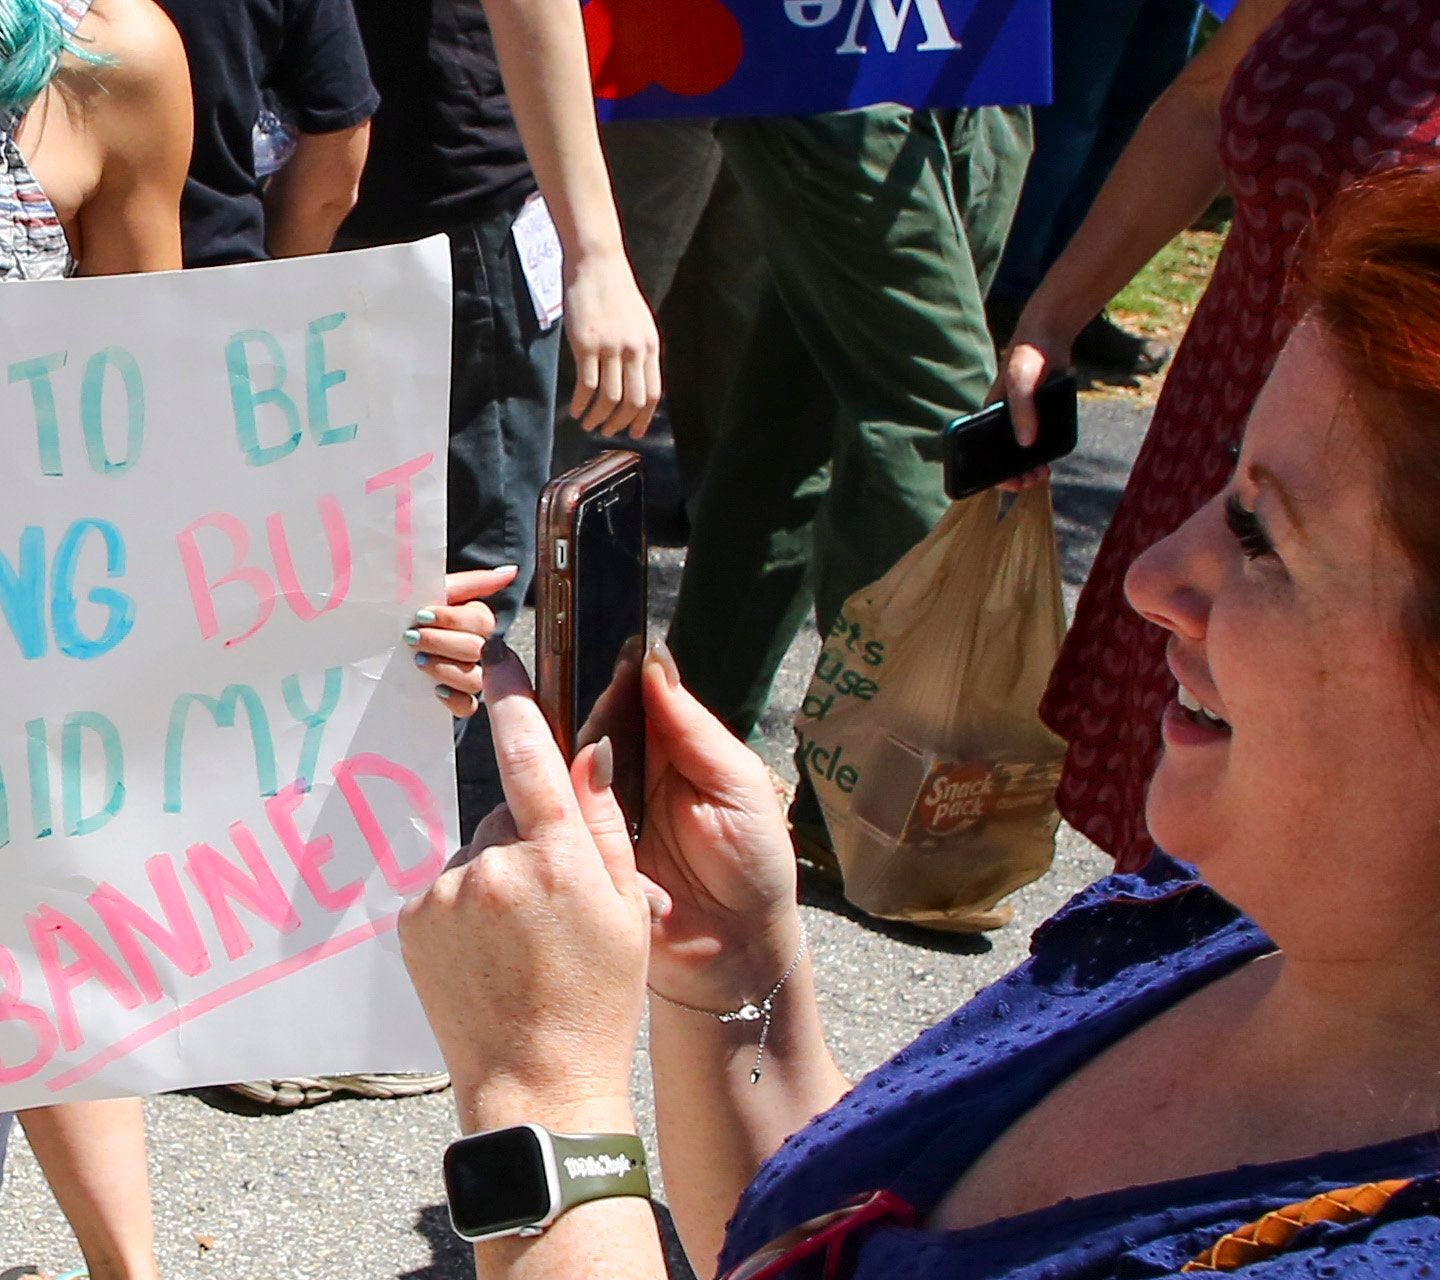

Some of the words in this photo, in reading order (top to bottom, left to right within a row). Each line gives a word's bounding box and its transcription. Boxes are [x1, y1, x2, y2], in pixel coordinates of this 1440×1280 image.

[8, 347, 147, 477] TO
[225, 311, 361, 469] BE
[177, 452, 437, 651] BUT
[163, 667, 346, 816] MY
[923, 768, 996, 806] Snack
[931, 799, 983, 826] pack
